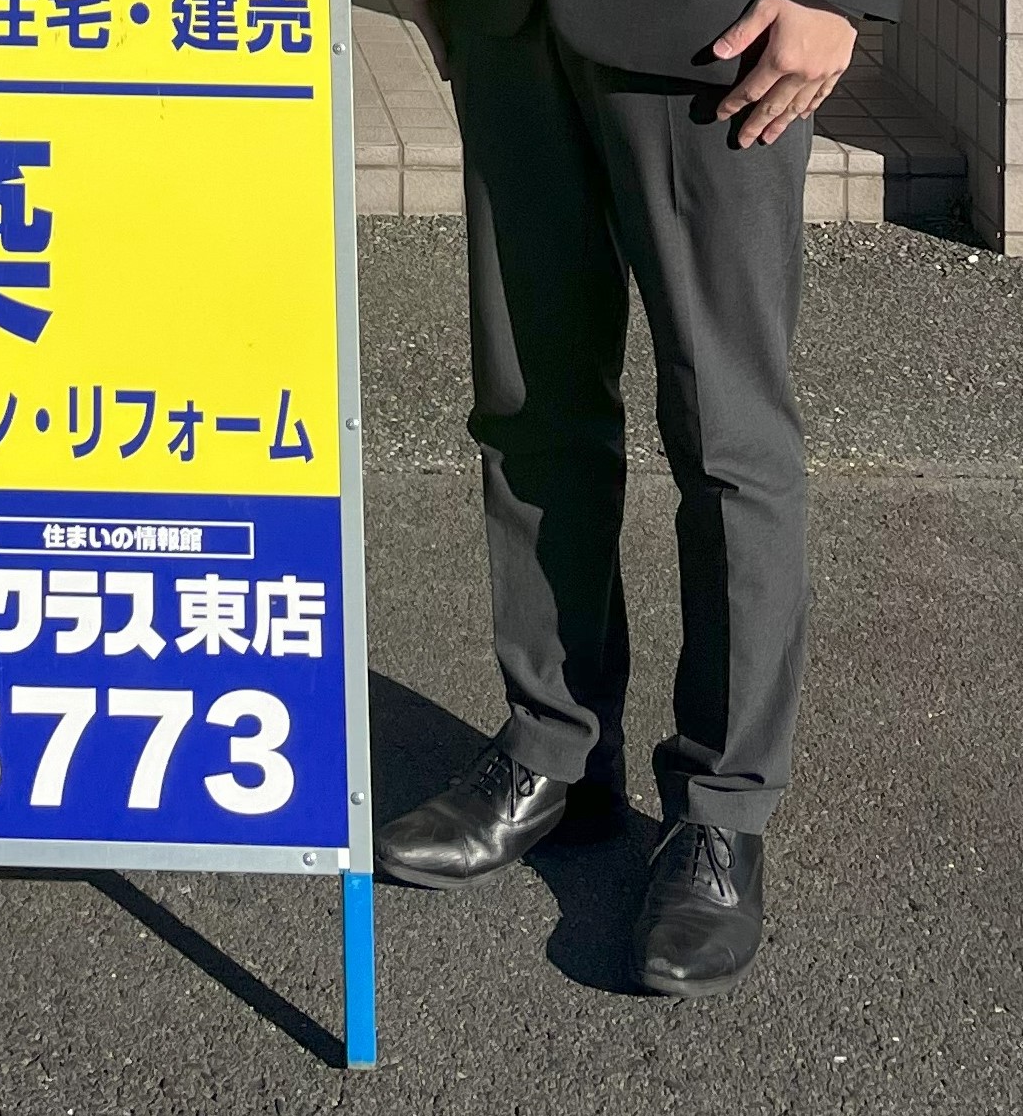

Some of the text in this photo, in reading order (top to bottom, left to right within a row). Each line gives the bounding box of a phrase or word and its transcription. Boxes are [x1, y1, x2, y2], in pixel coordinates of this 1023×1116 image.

[43, 523, 203, 552] 住まいの情報館
